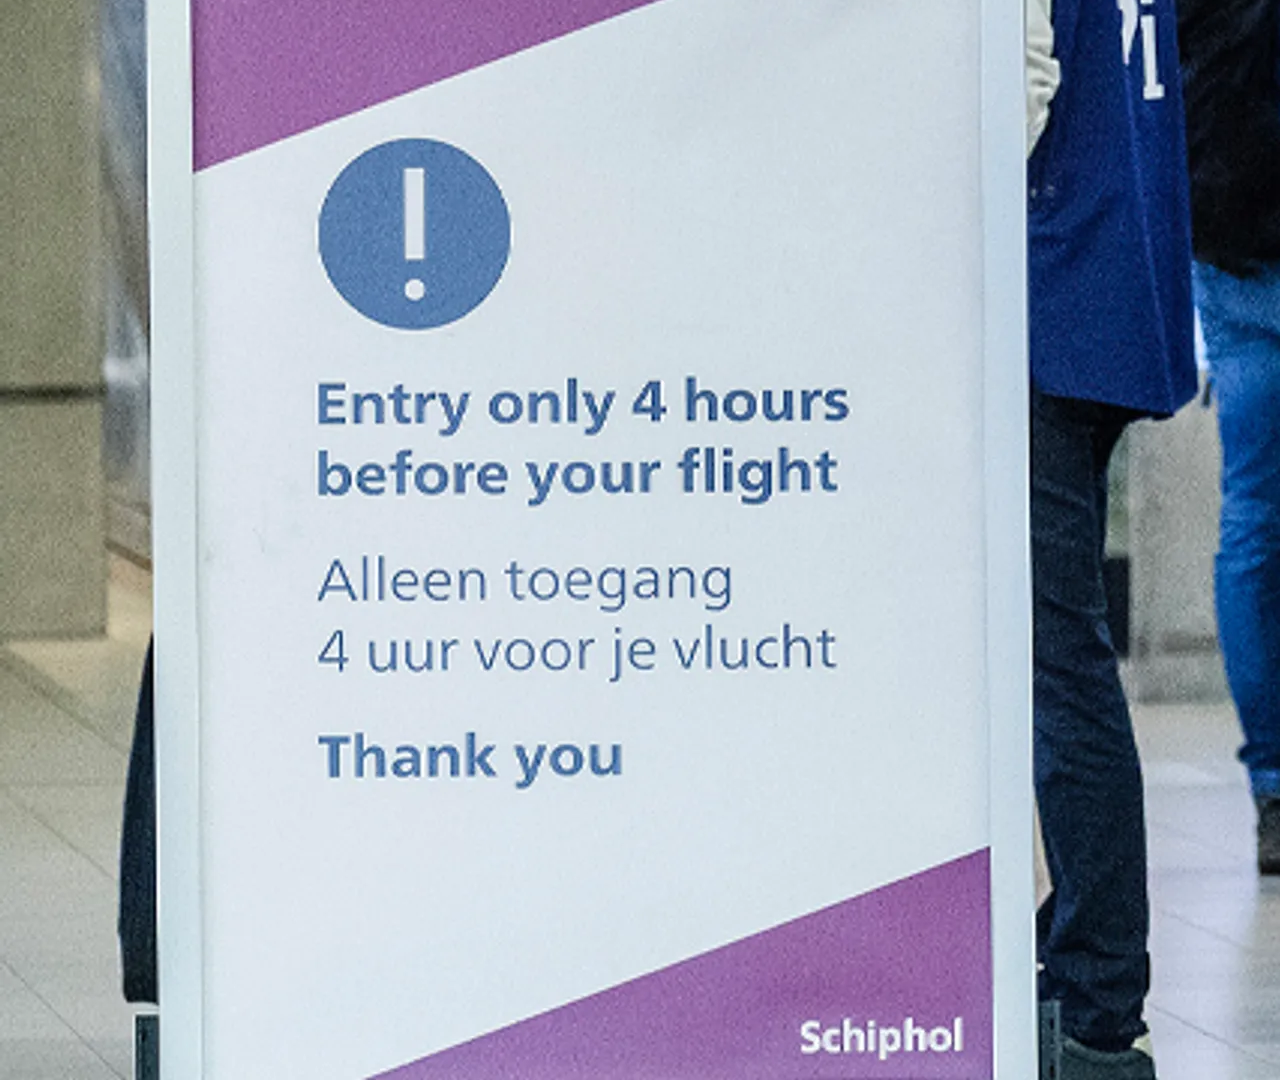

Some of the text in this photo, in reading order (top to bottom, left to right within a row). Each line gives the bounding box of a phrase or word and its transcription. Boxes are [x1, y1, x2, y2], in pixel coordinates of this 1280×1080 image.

[318, 376, 850, 437] Entry only 4 hours
[318, 446, 838, 507] before your flight
[317, 555, 733, 613] Alleen toegang
[317, 622, 837, 683] 4 uur voor je vlucht
[317, 731, 622, 790] Thank you
[800, 1016, 964, 1060] Schiphol
